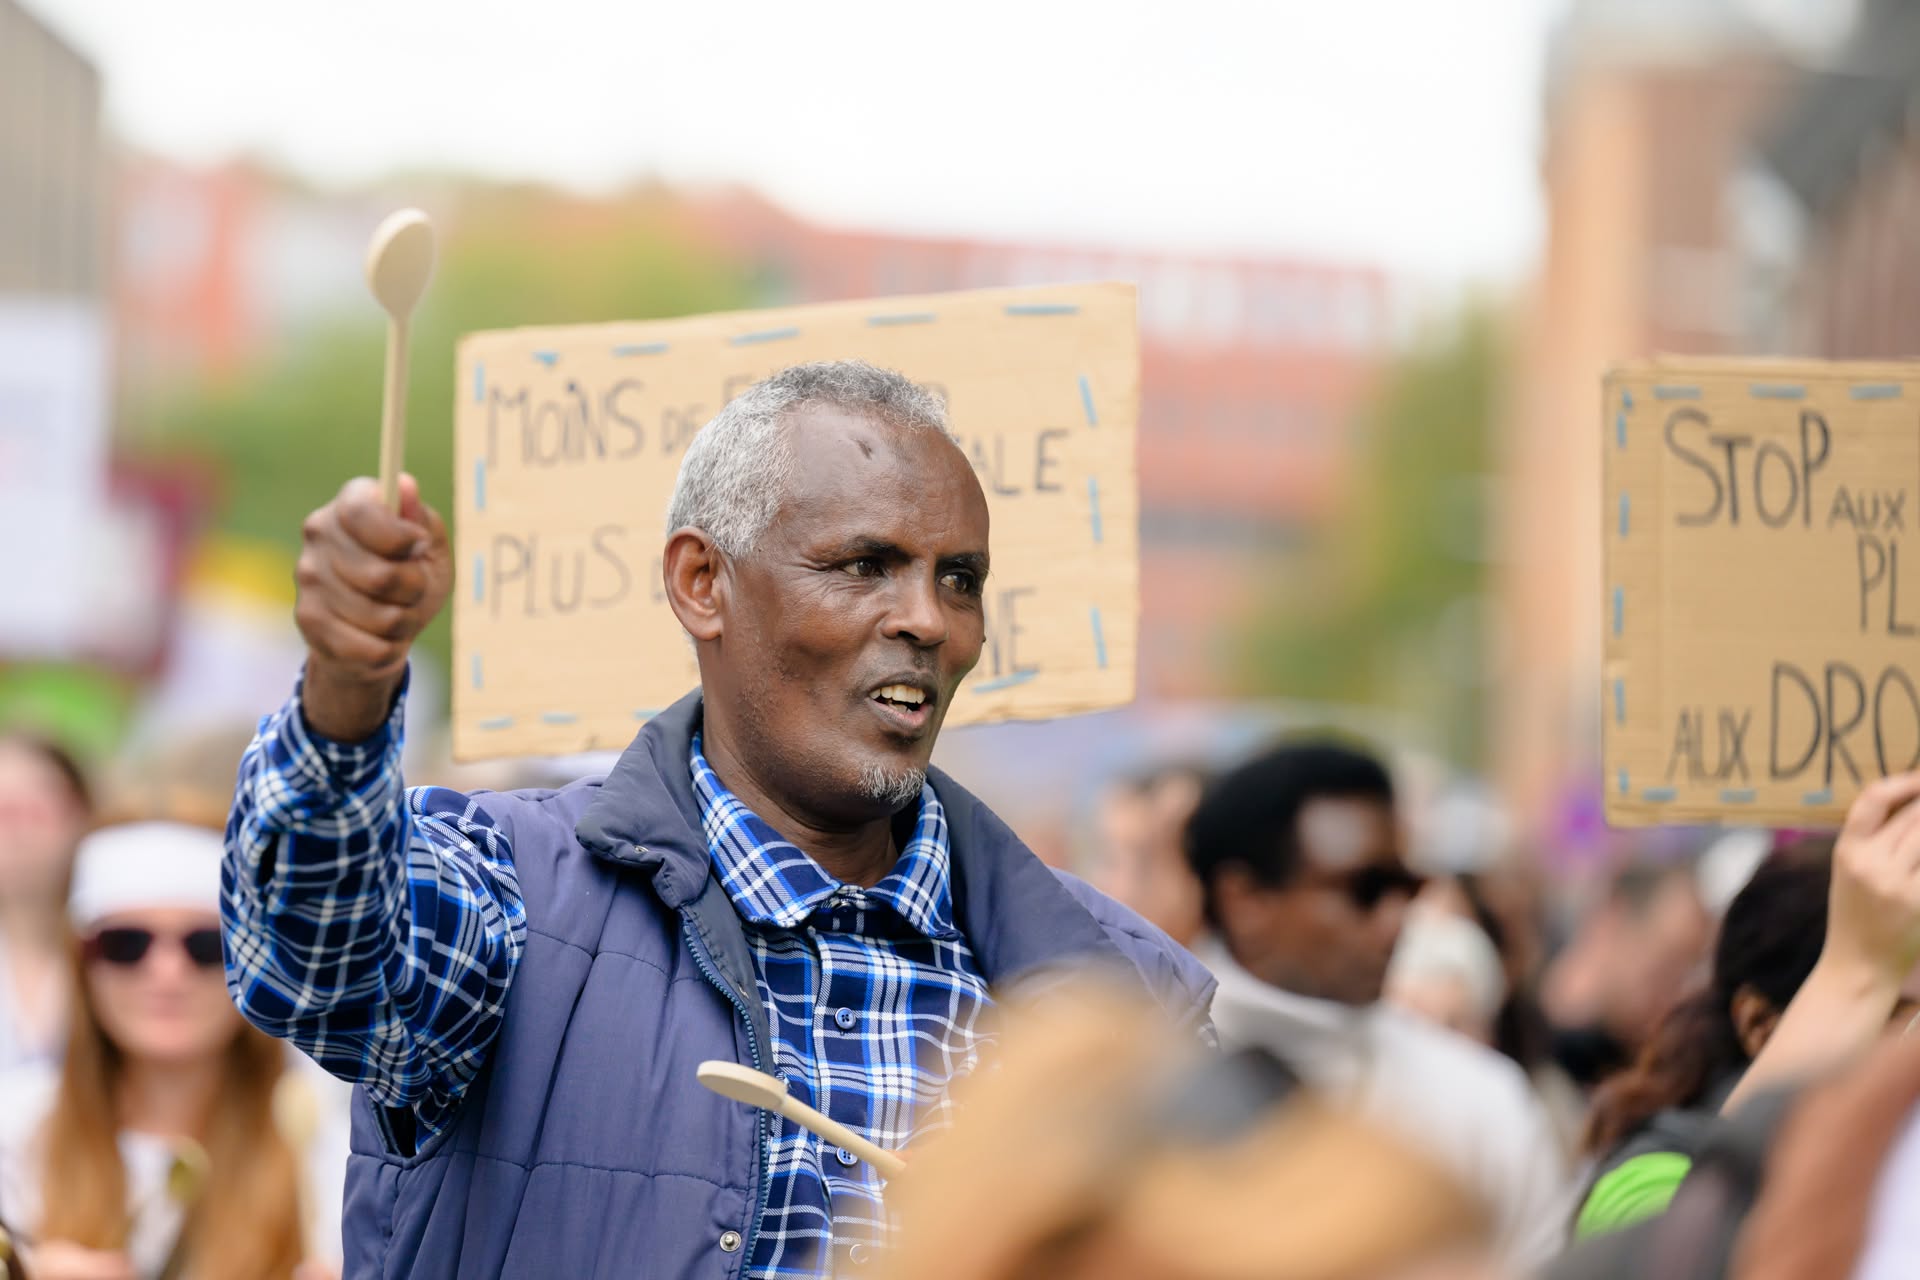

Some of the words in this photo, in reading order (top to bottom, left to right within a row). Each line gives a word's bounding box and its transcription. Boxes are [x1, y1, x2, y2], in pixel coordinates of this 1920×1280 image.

[968, 427, 1071, 496] ALE
[1664, 407, 1831, 529] STOP
[1827, 485, 1907, 533] AUX
[490, 524, 633, 620] PLUS
[1857, 533, 1918, 635] PL
[1665, 706, 1753, 785] AUX
[1769, 659, 1920, 786] DRO
